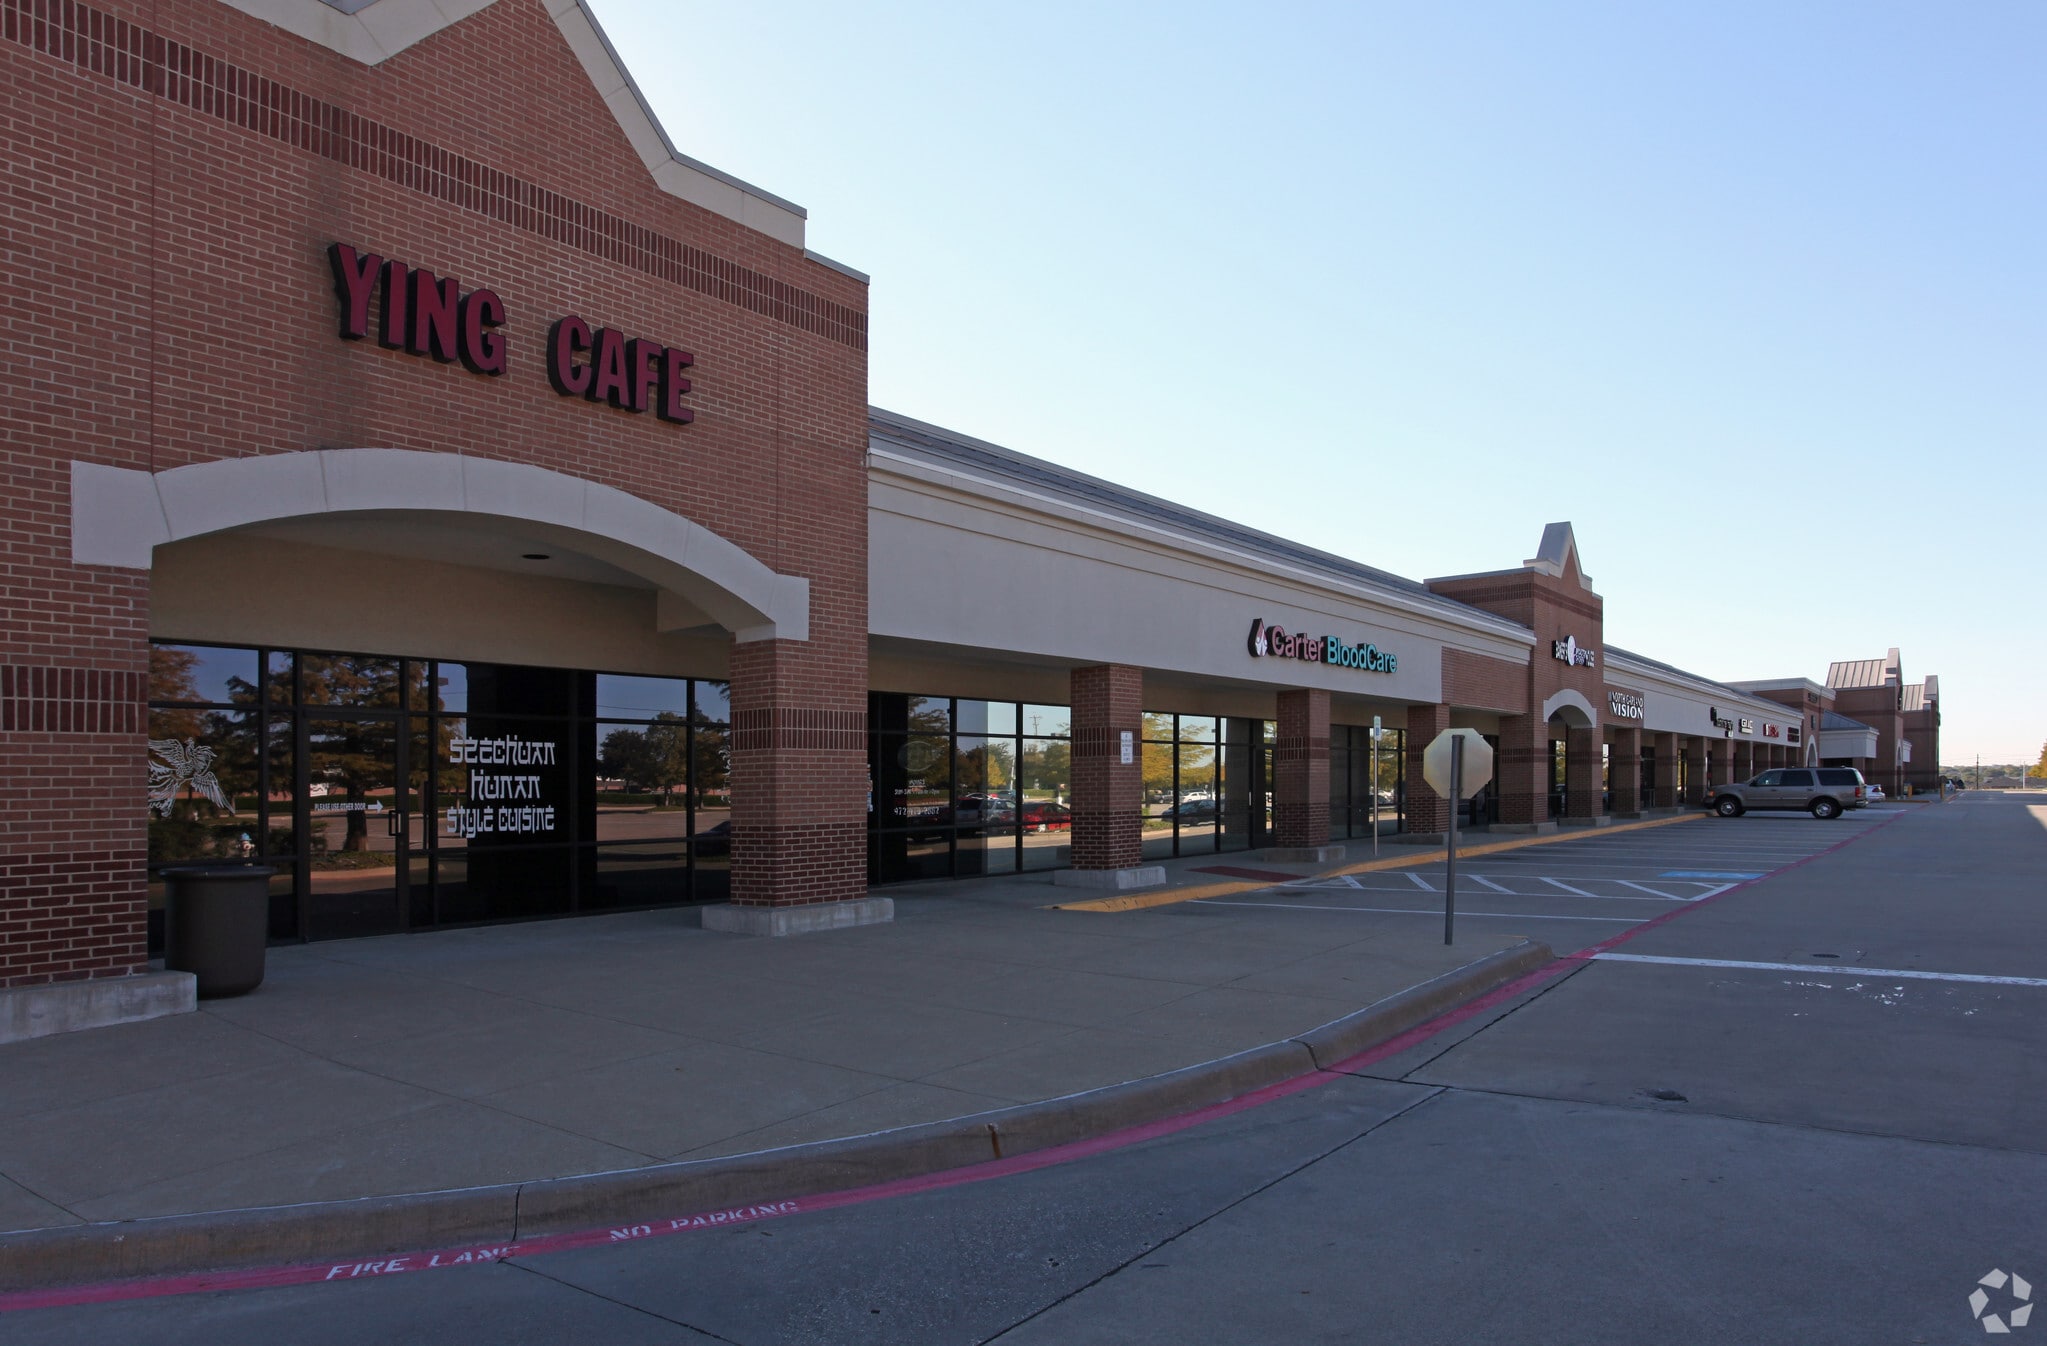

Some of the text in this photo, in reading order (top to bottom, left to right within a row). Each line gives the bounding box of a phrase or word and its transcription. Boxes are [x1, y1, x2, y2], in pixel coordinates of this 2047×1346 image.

[327, 242, 694, 425] YING CAFE
[1268, 625, 1397, 673] Carter BloodCare
[1612, 701, 1643, 719] VISION
[610, 1201, 798, 1241] NO PARKING
[326, 1258, 410, 1279] FIRE
